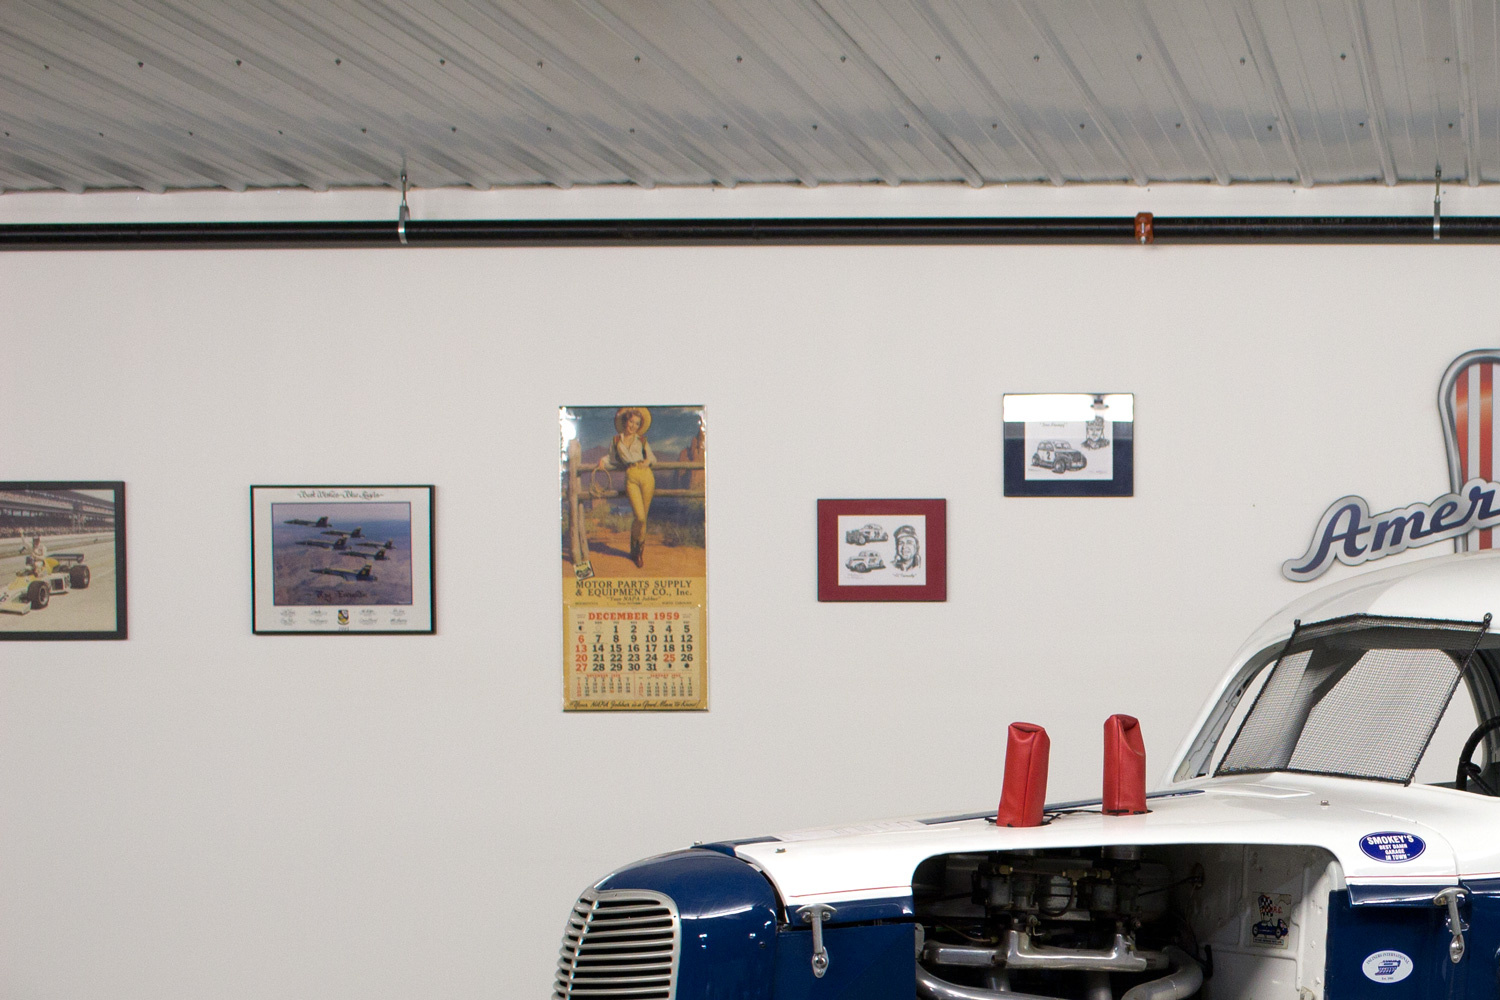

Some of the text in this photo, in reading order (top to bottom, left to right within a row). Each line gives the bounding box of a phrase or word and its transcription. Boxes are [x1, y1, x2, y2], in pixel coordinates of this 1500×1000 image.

[575, 580, 692, 588] MOTOR PARTS SUPPLY
[575, 588, 692, 597] & EQUIPMENT CO., Inc.
[588, 612, 680, 620] DECEMBER 1959
[614, 625, 690, 633] 1 2 3 4 5
[578, 635, 693, 643] 6 7 8 9 10 11 12
[576, 644, 693, 652] 13 14 15 16 17 18 19
[576, 654, 693, 663] 20 21 22 23 24 25 26
[576, 663, 657, 671] 27 28 29 30 31
[1366, 834, 1414, 845] SMOKEY'S
